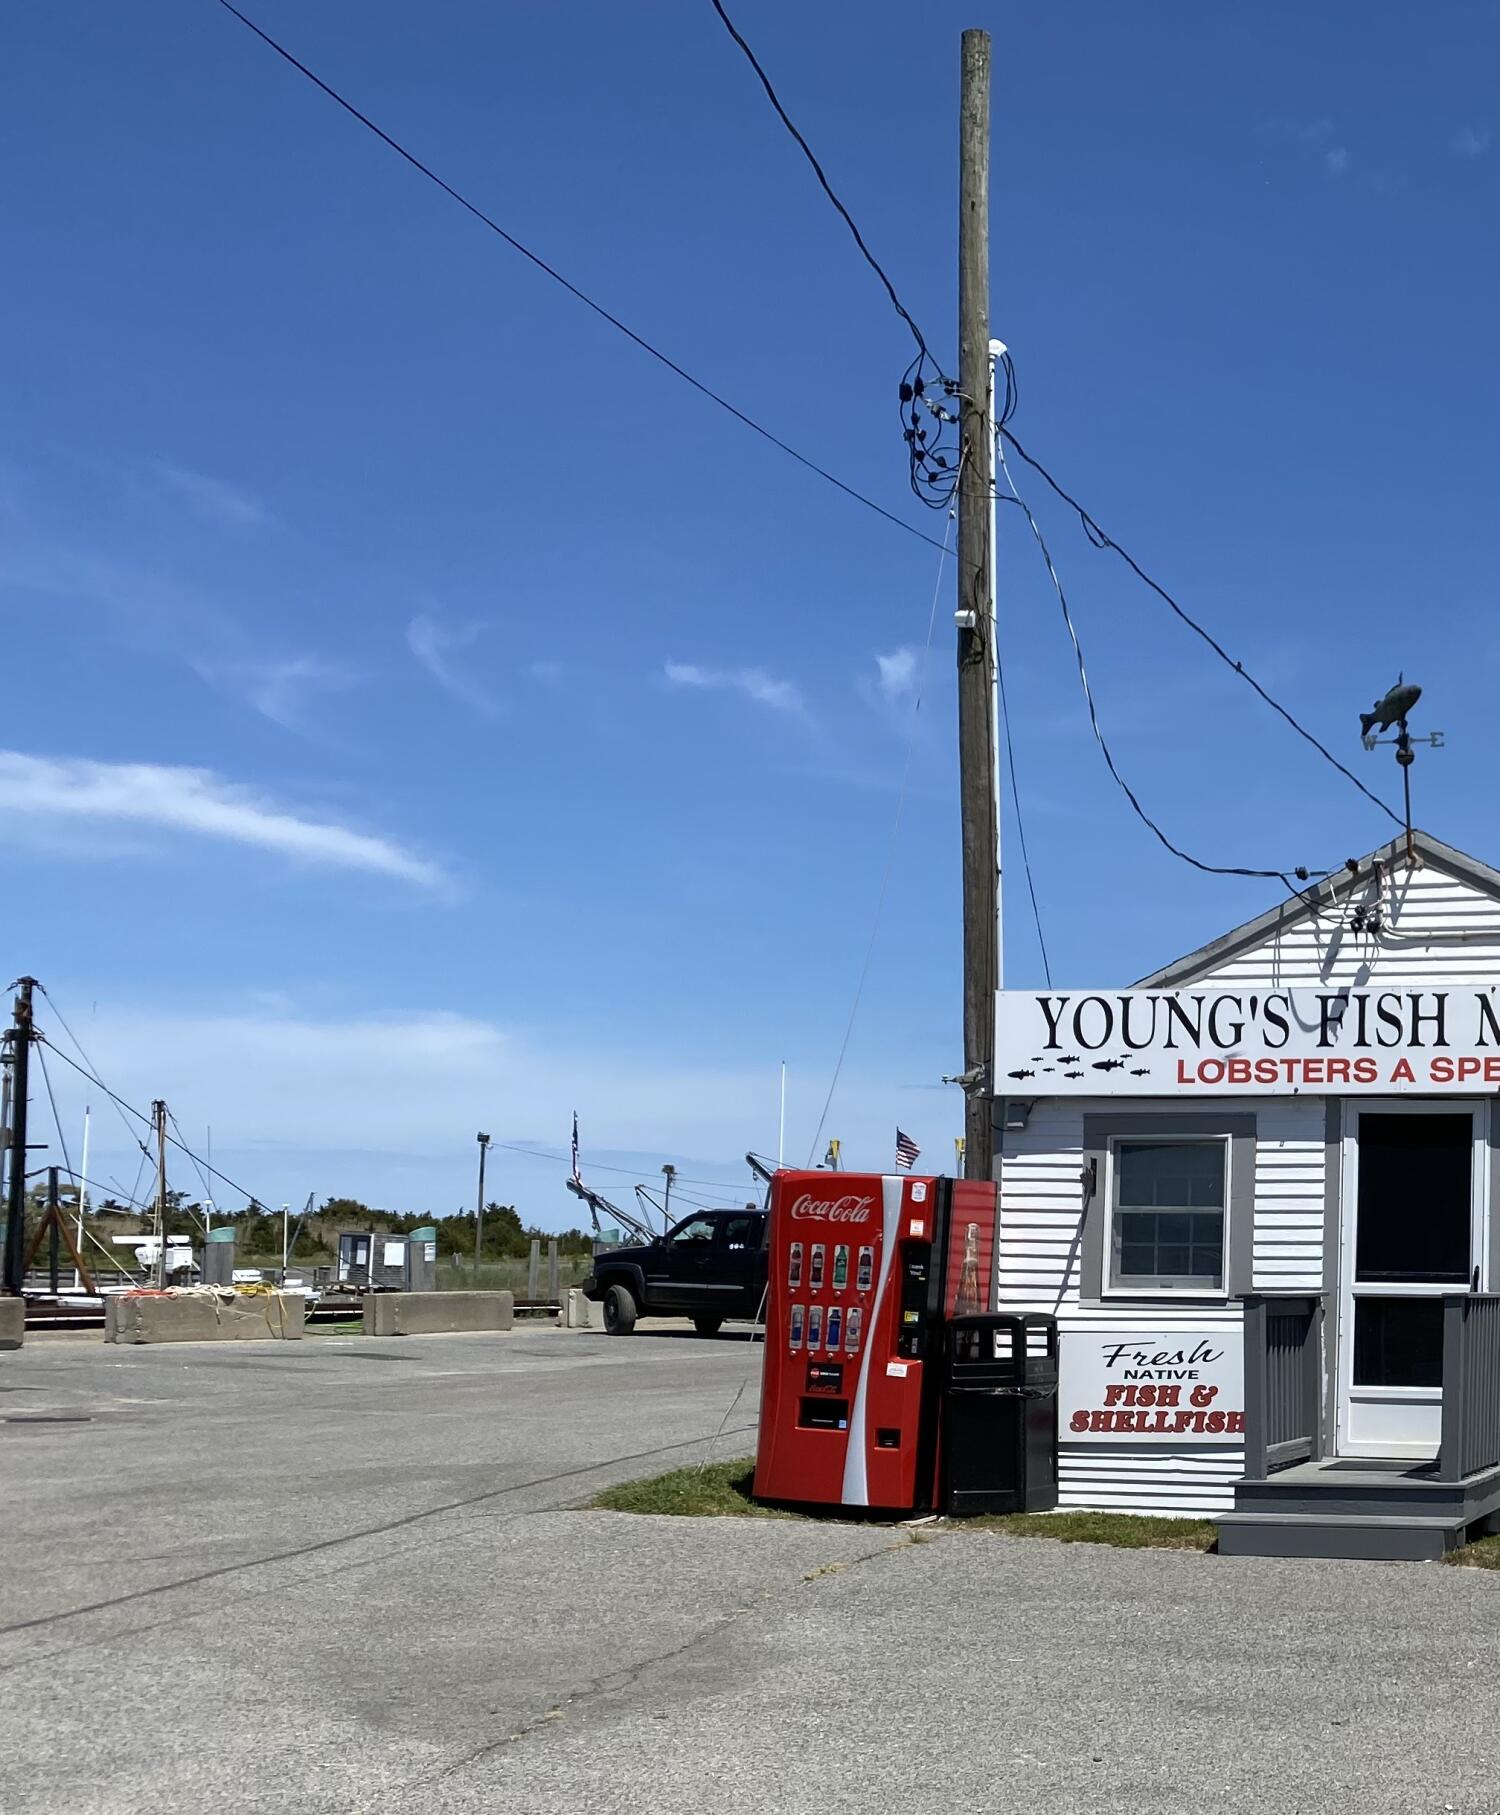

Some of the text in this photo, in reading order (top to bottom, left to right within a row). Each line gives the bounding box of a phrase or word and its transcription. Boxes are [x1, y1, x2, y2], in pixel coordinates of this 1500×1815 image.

[1035, 994, 1290, 1050] YOUNG'S
[1314, 992, 1450, 1048] FISH
[1177, 1057, 1378, 1084] LOBSTERS
[1390, 1057, 1416, 1084] A
[791, 1193, 876, 1222] Coca-Cola
[1101, 1339, 1225, 1368] Fresh
[1123, 1369, 1200, 1380] NATIVE
[1103, 1384, 1219, 1408] FISH &
[1069, 1410, 1245, 1433] SHELLFISH
